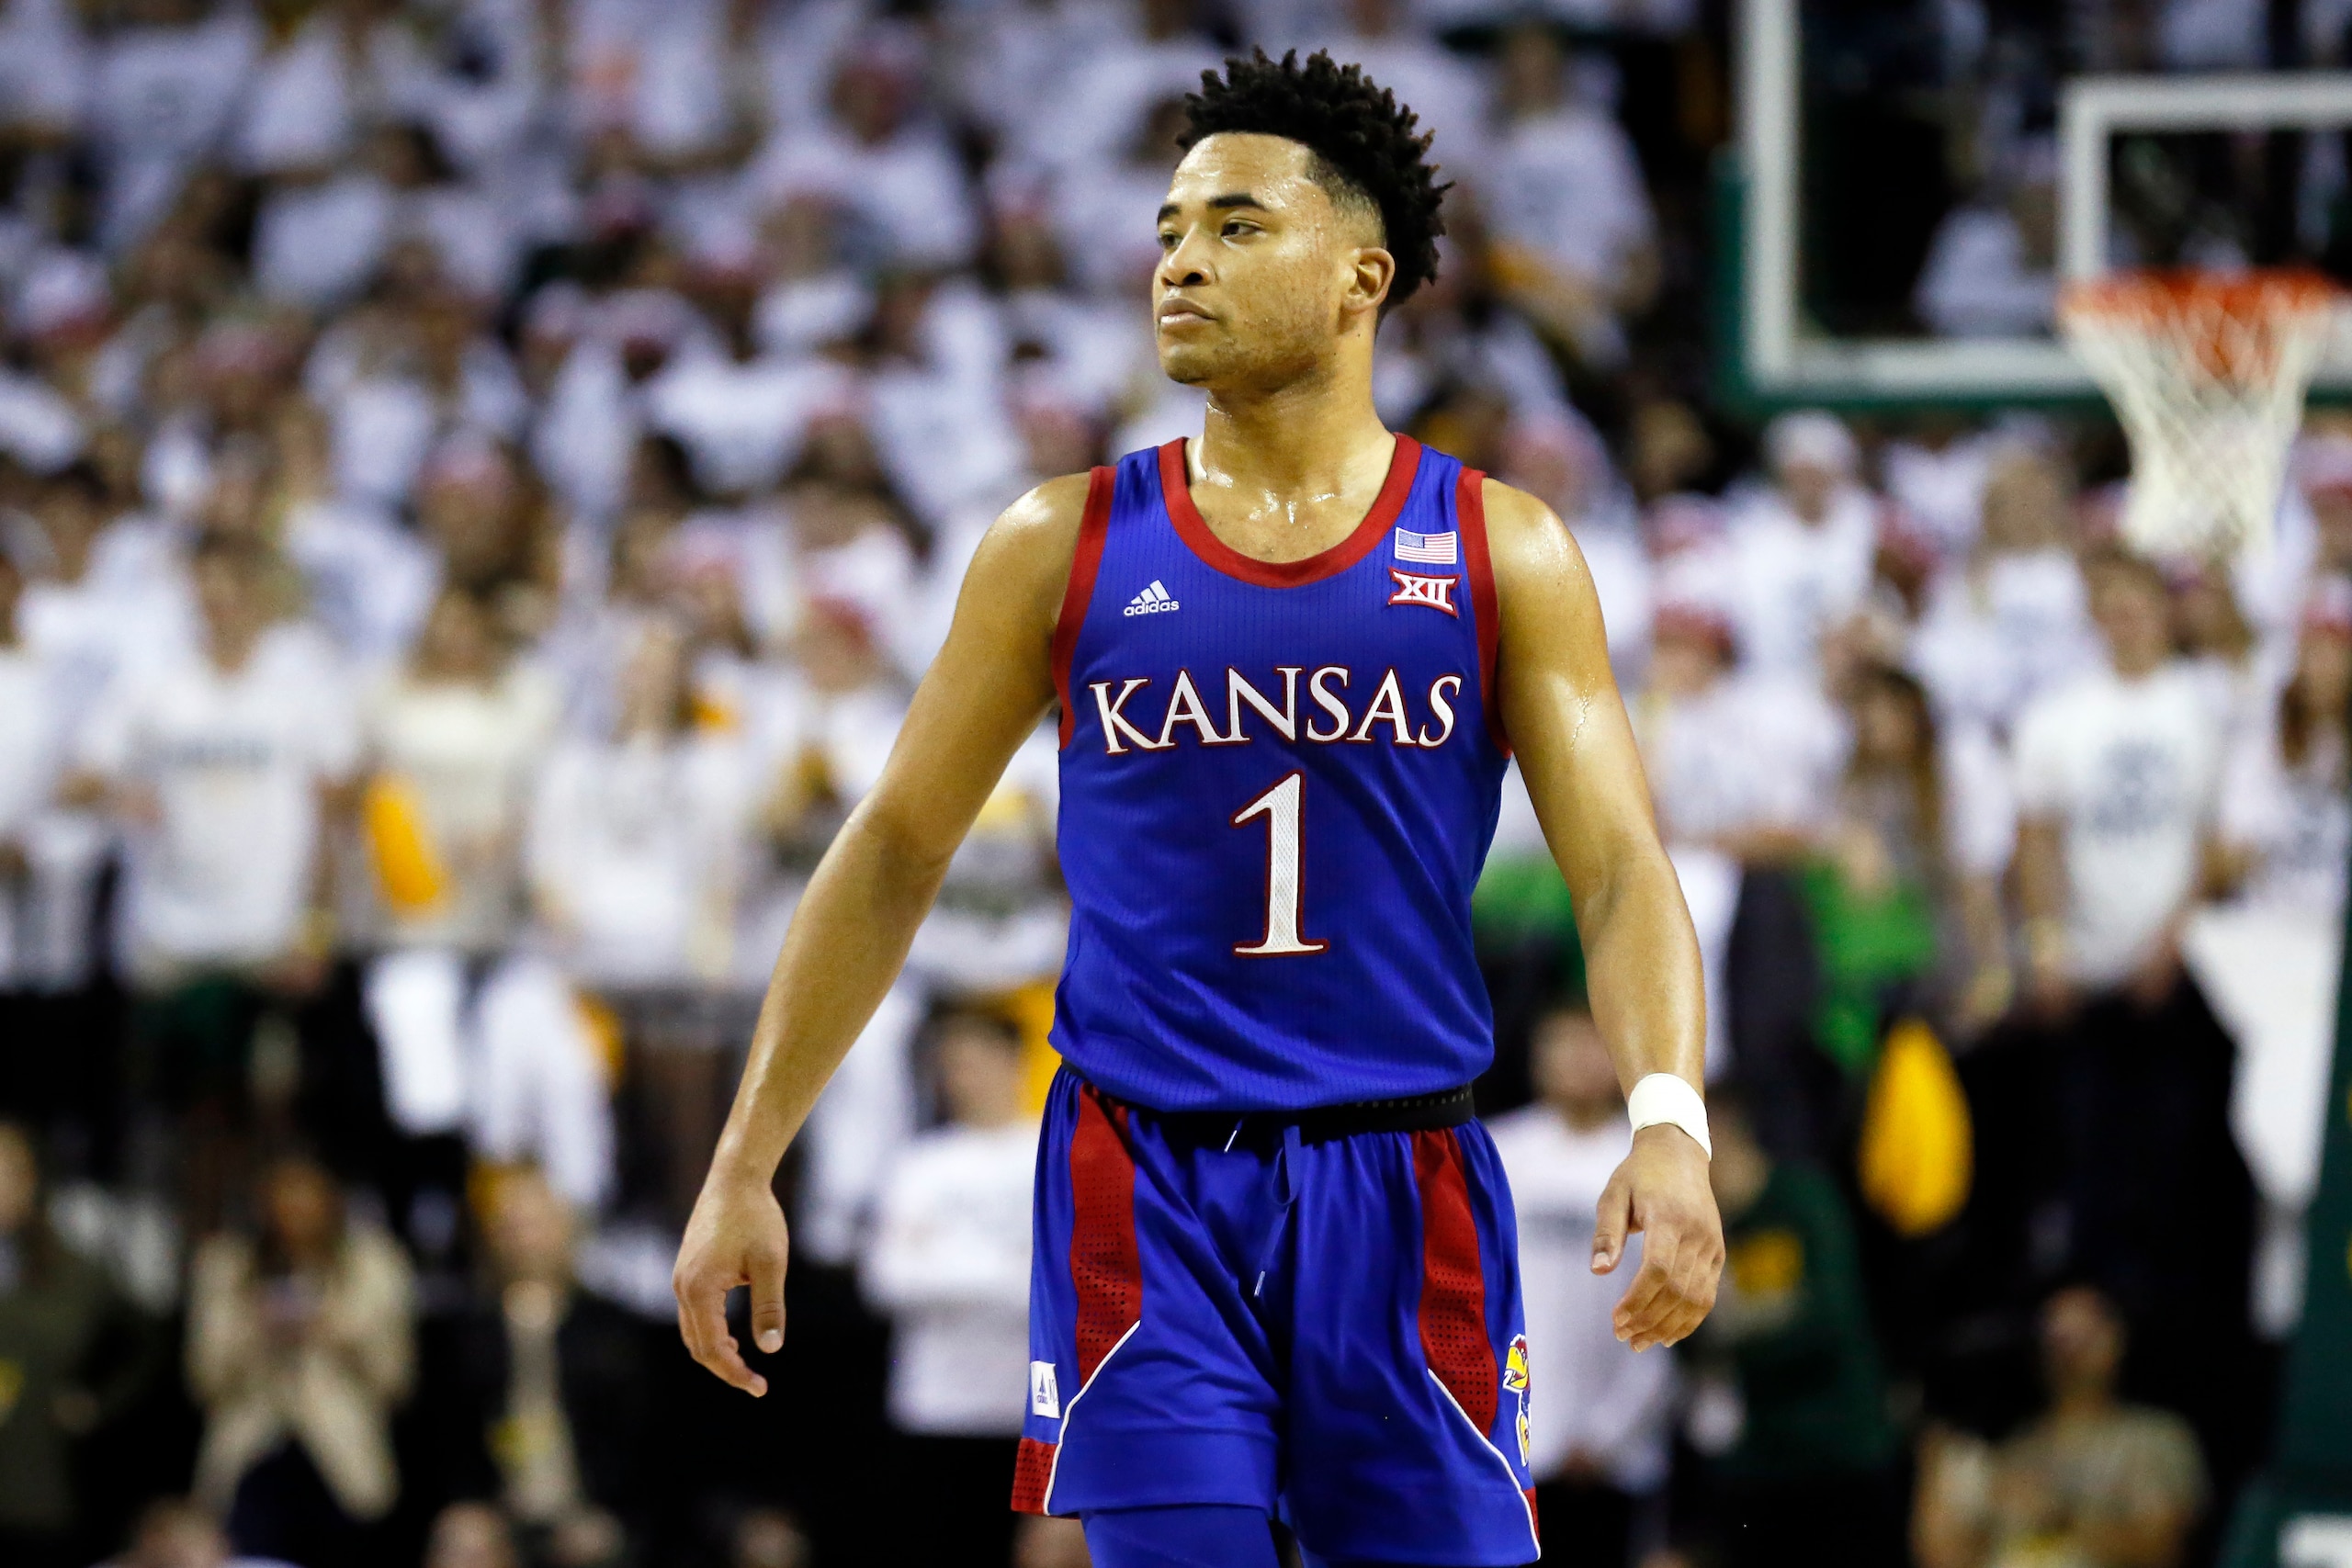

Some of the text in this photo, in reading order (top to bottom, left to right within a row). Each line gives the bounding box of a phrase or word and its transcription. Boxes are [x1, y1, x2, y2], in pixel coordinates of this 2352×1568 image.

[1124, 600, 1180, 616] adidas
[1088, 665, 1463, 755] KANSAS
[1232, 771, 1327, 956] 1
